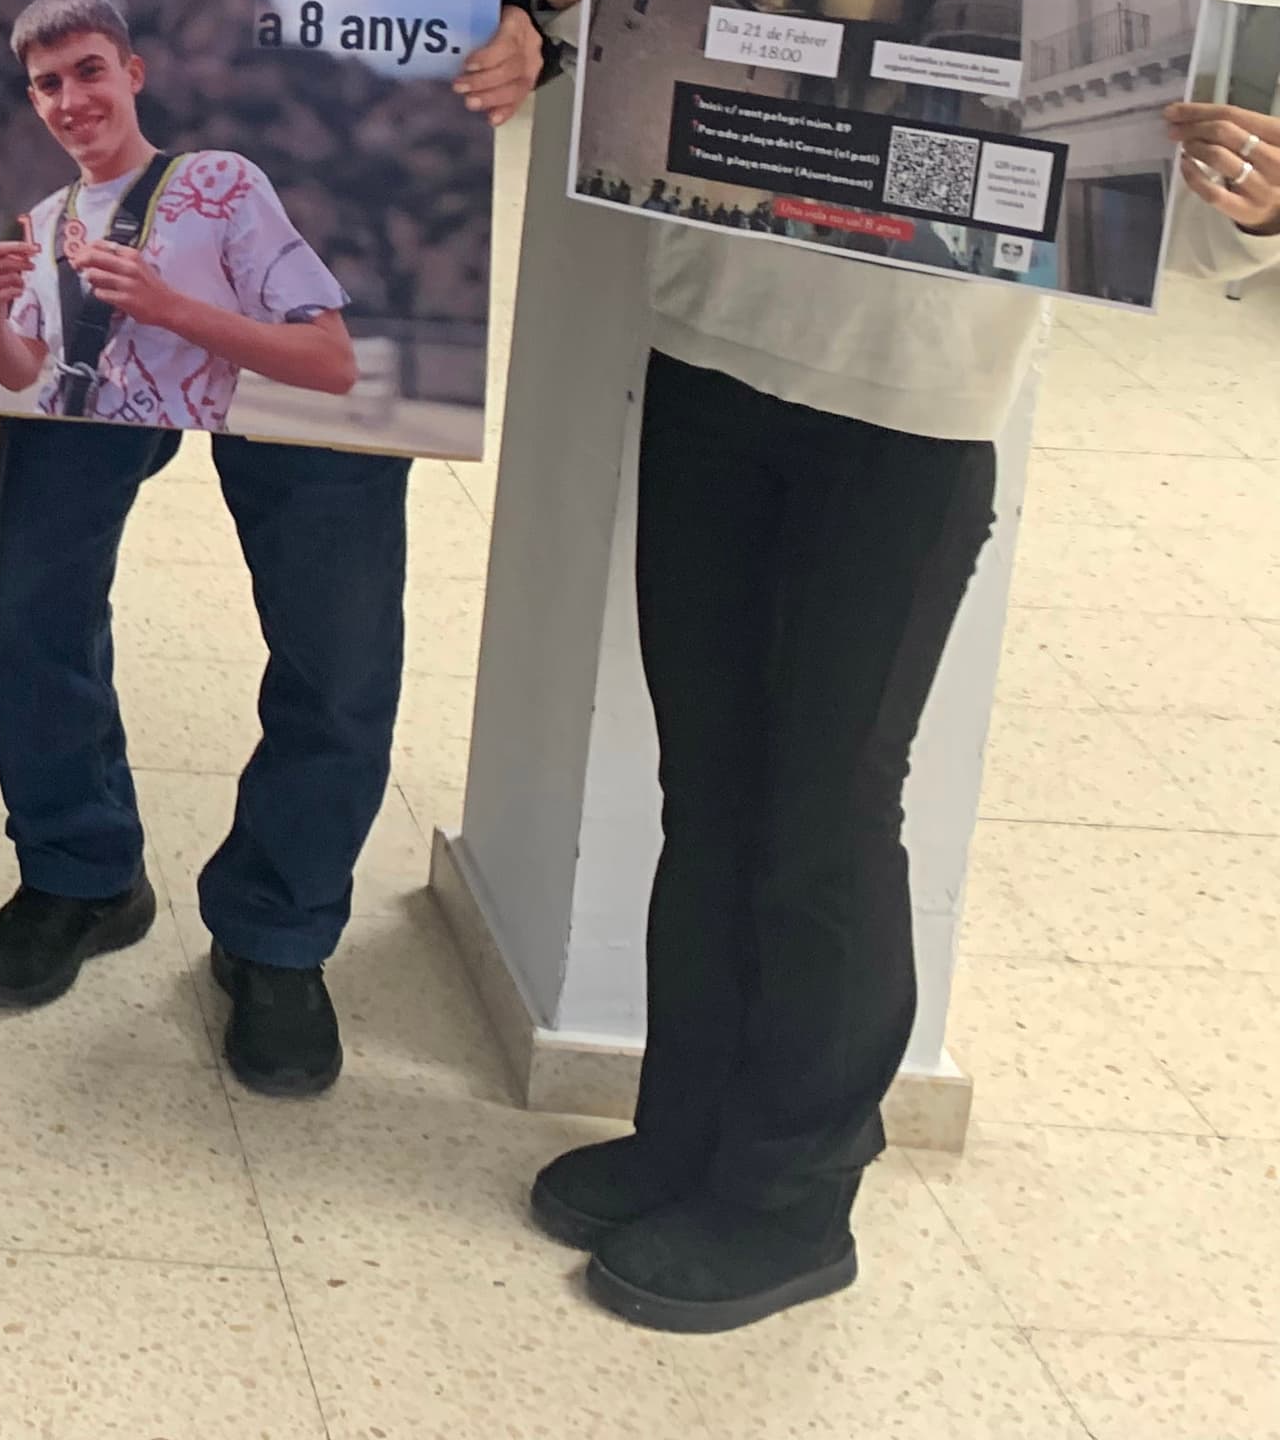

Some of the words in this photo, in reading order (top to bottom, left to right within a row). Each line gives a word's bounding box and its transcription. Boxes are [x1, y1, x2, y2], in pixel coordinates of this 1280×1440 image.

[259, 11, 283, 49] a
[300, 1, 324, 49] 8
[340, 15, 460, 63] anys.
[743, 22, 762, 38] 21
[767, 27, 782, 40] de
